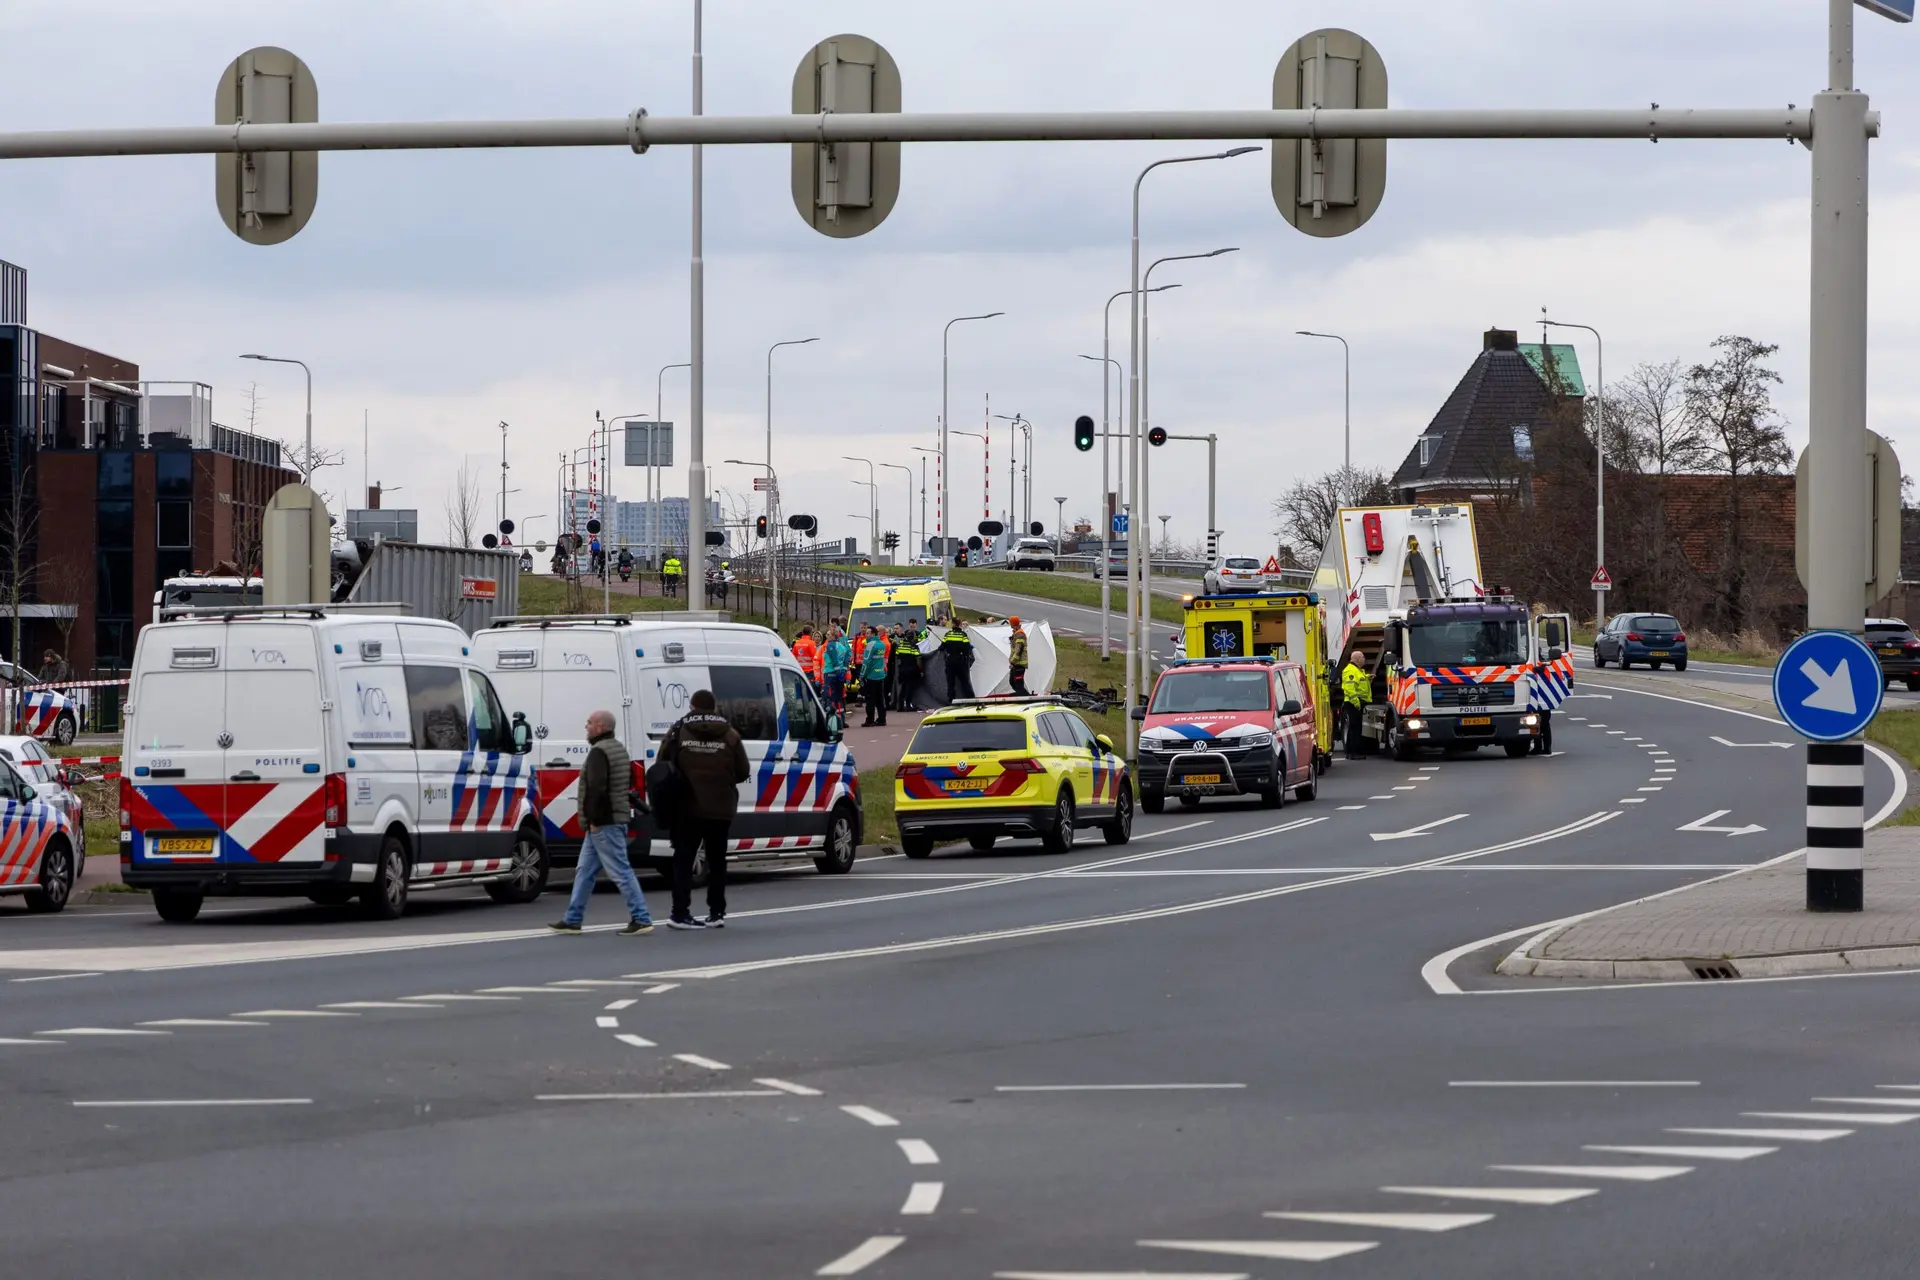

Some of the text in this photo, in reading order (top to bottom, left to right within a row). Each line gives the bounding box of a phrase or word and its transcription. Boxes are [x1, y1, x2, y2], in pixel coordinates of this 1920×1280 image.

[463, 582, 476, 596] HKS
[151, 759, 172, 768] 0393
[255, 757, 302, 766] POLITIE
[1185, 775, 1218, 783] S-994-NR
[947, 779, 982, 789] K-742-JJ
[161, 839, 207, 850] VBS-27-Z
